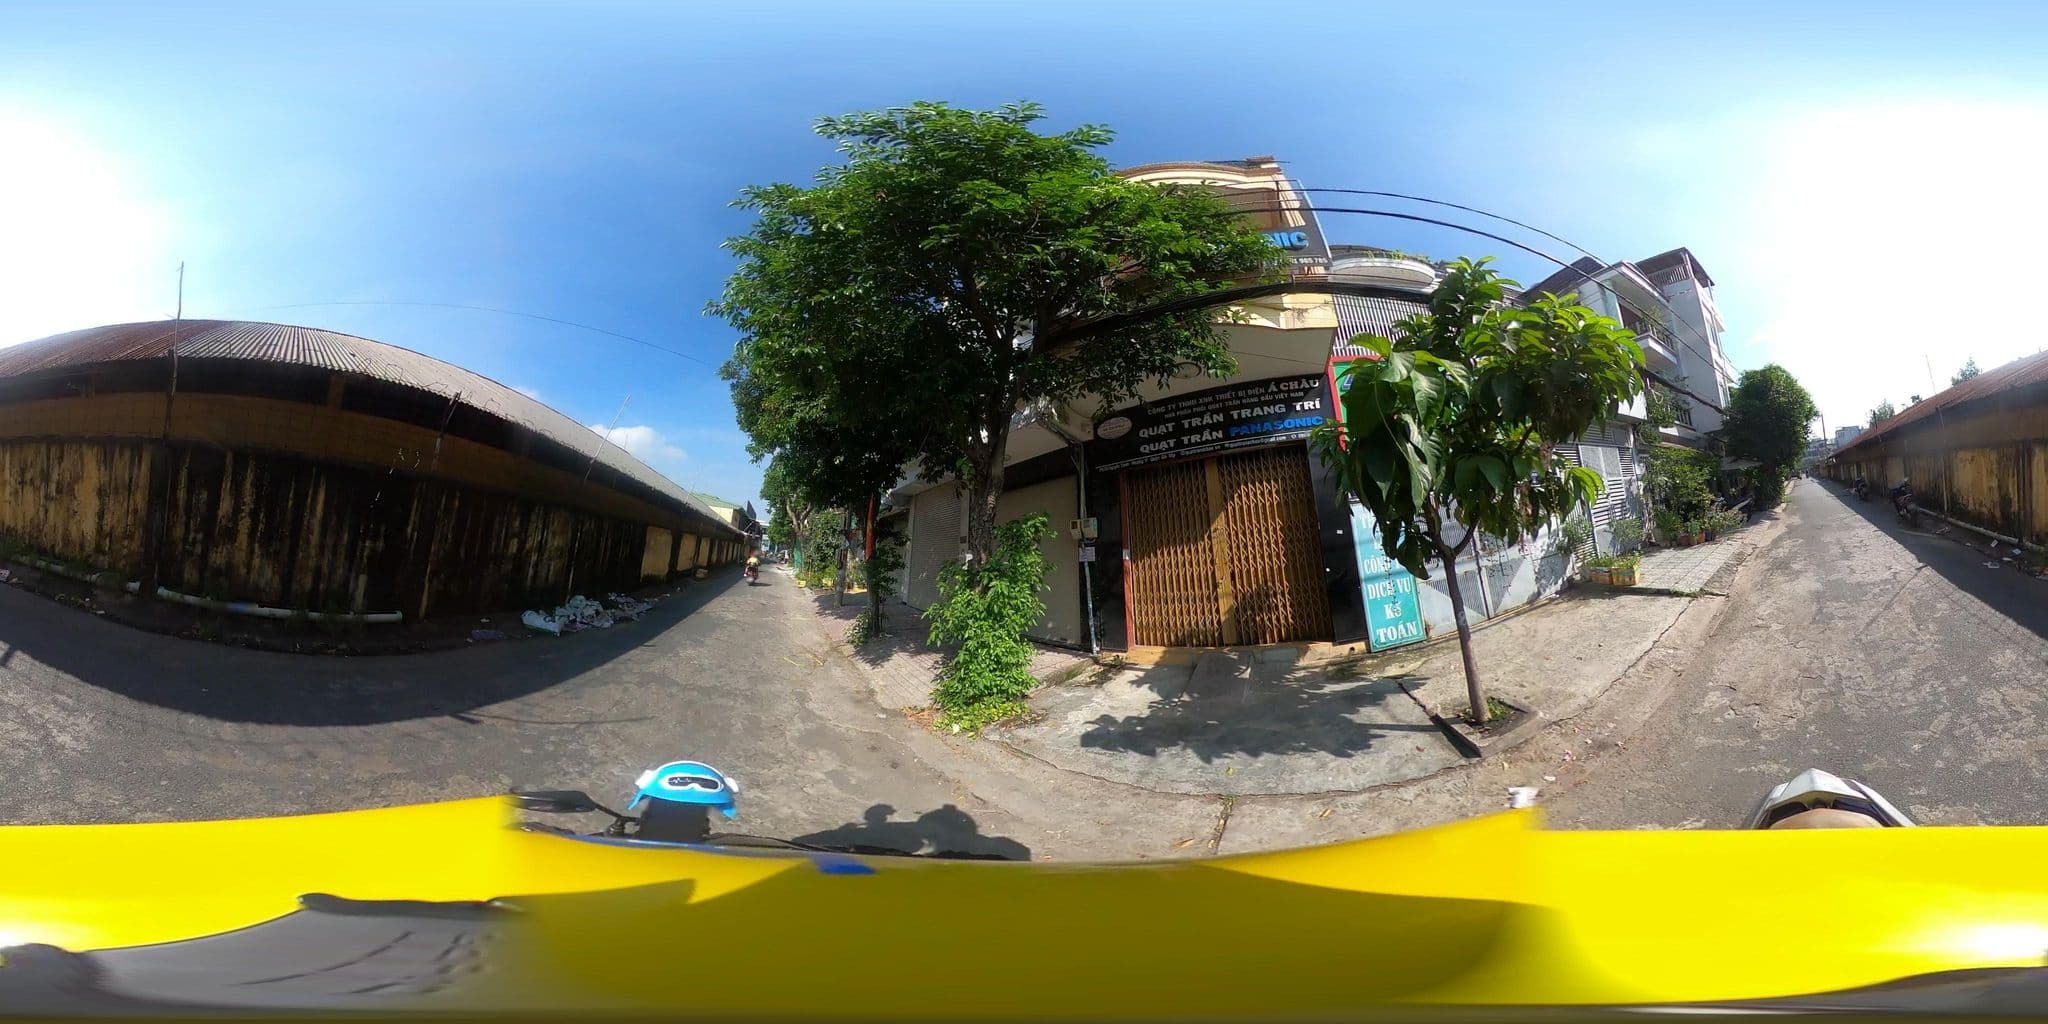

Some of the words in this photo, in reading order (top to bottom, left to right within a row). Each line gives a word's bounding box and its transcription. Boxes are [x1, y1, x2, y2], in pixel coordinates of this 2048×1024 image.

[1147, 405, 1166, 415] CÔNG
[1168, 402, 1177, 411] TY
[1268, 381, 1278, 392] Á
[1280, 378, 1320, 391] CHÂU
[1139, 422, 1175, 438] QUẠT
[1181, 411, 1224, 429] TRẦN
[1230, 403, 1286, 420] TRANG
[1292, 397, 1321, 411] TRÍ
[1140, 439, 1177, 454] QUẠT
[1180, 429, 1223, 445] TRẦN
[1229, 415, 1323, 437] PANASONIC
[1367, 578, 1395, 601] DỊCH
[1396, 576, 1412, 596] VỤ
[1384, 601, 1402, 620] KẾ
[1376, 620, 1418, 643] TOÁN
